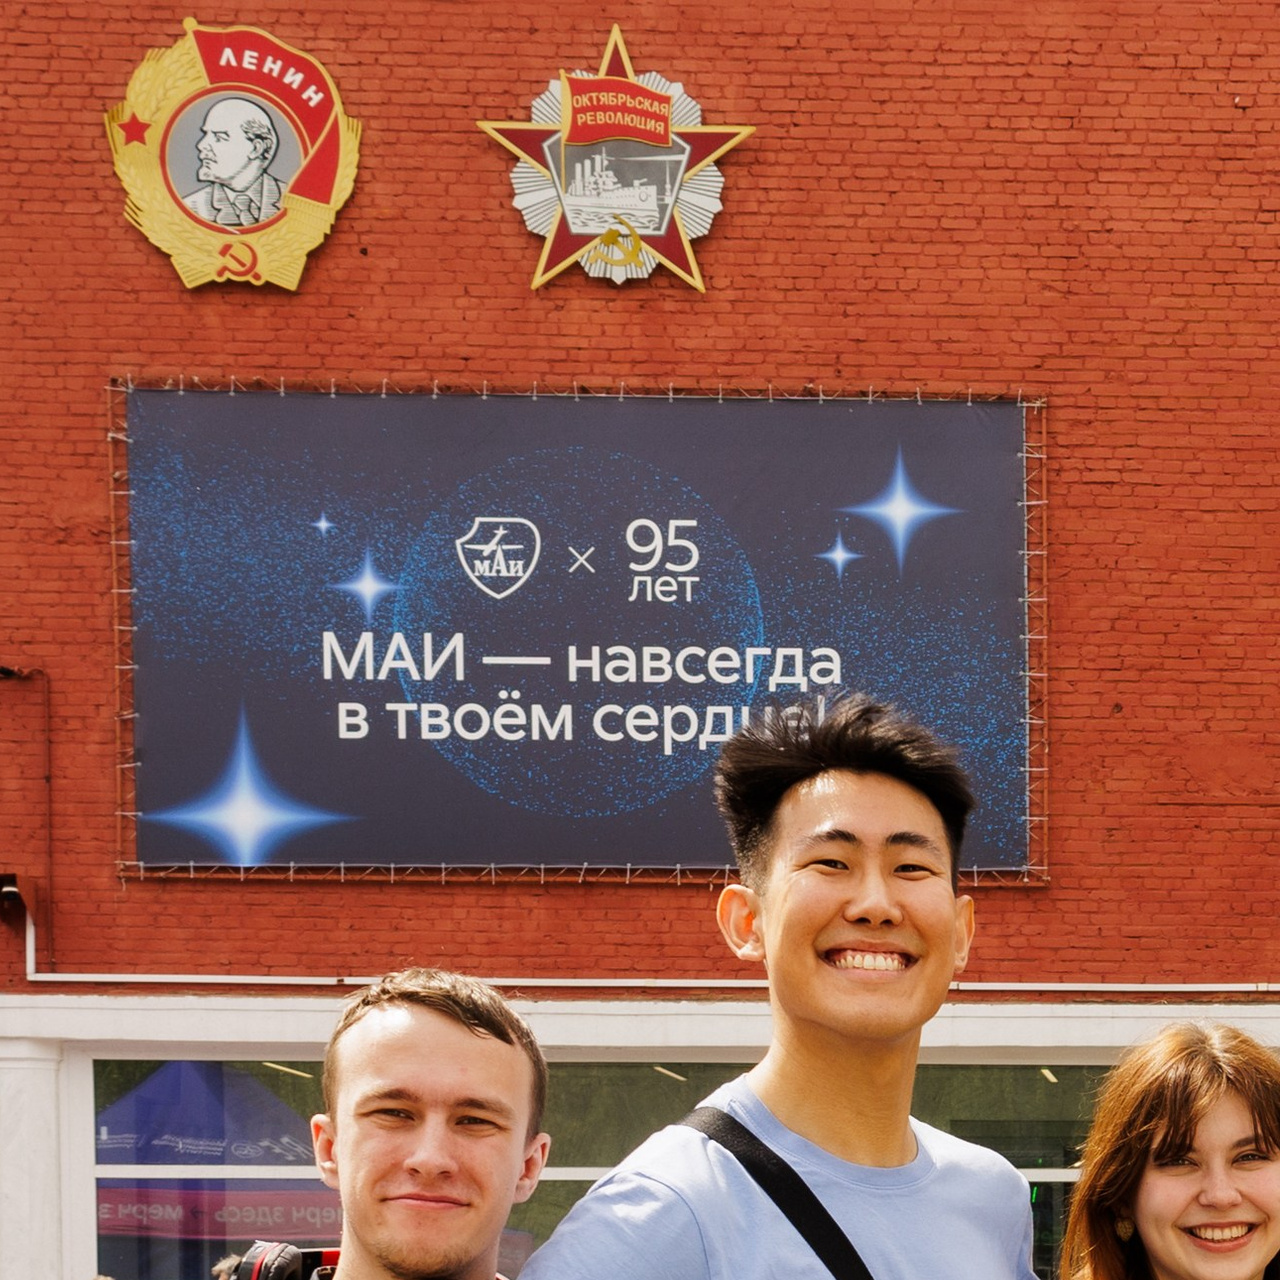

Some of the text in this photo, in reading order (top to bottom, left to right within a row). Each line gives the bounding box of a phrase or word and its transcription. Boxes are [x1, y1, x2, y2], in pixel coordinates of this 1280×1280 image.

[219, 47, 324, 107] ЛЕНИН
[573, 92, 669, 117] ОКТЯБРЬСКАЯ
[576, 111, 665, 135] РЕВОЛЮЦИЯ
[625, 518, 700, 572] 95
[628, 575, 700, 602] лет
[322, 631, 465, 681] МАИ
[568, 645, 842, 692] навсегда
[338, 702, 369, 739] в
[385, 689, 573, 741] твоём
